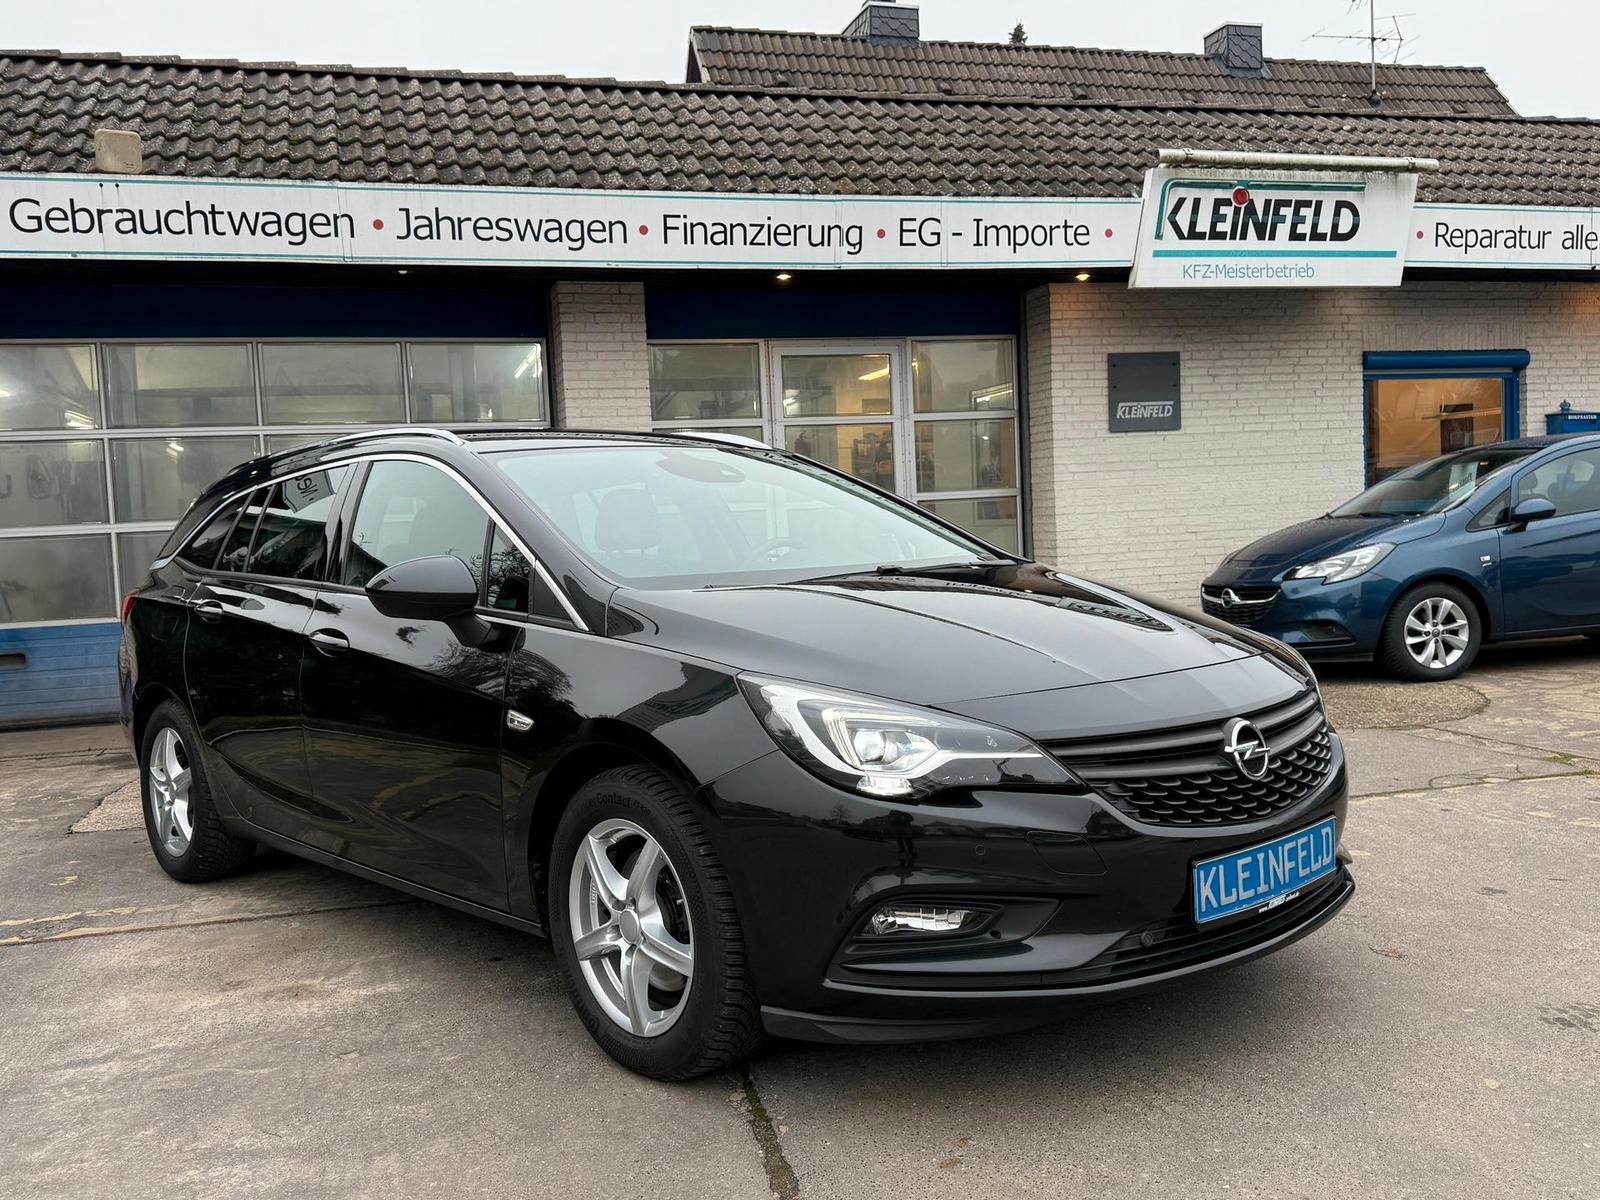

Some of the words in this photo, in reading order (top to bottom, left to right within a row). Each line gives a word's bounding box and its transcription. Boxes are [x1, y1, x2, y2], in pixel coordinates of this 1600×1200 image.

[10, 198, 354, 245] Gebrauchtwagen
[397, 207, 627, 251] Jahreswagen
[663, 215, 862, 256] Finanzierung
[900, 217, 941, 247] EG
[973, 218, 1090, 254] Importe
[1436, 222, 1553, 255] Reparatur
[1562, 224, 1599, 250] alle
[1183, 264, 1315, 279] KFZ-Meisterbetrieb
[1200, 826, 1334, 912] KLEINFELD
